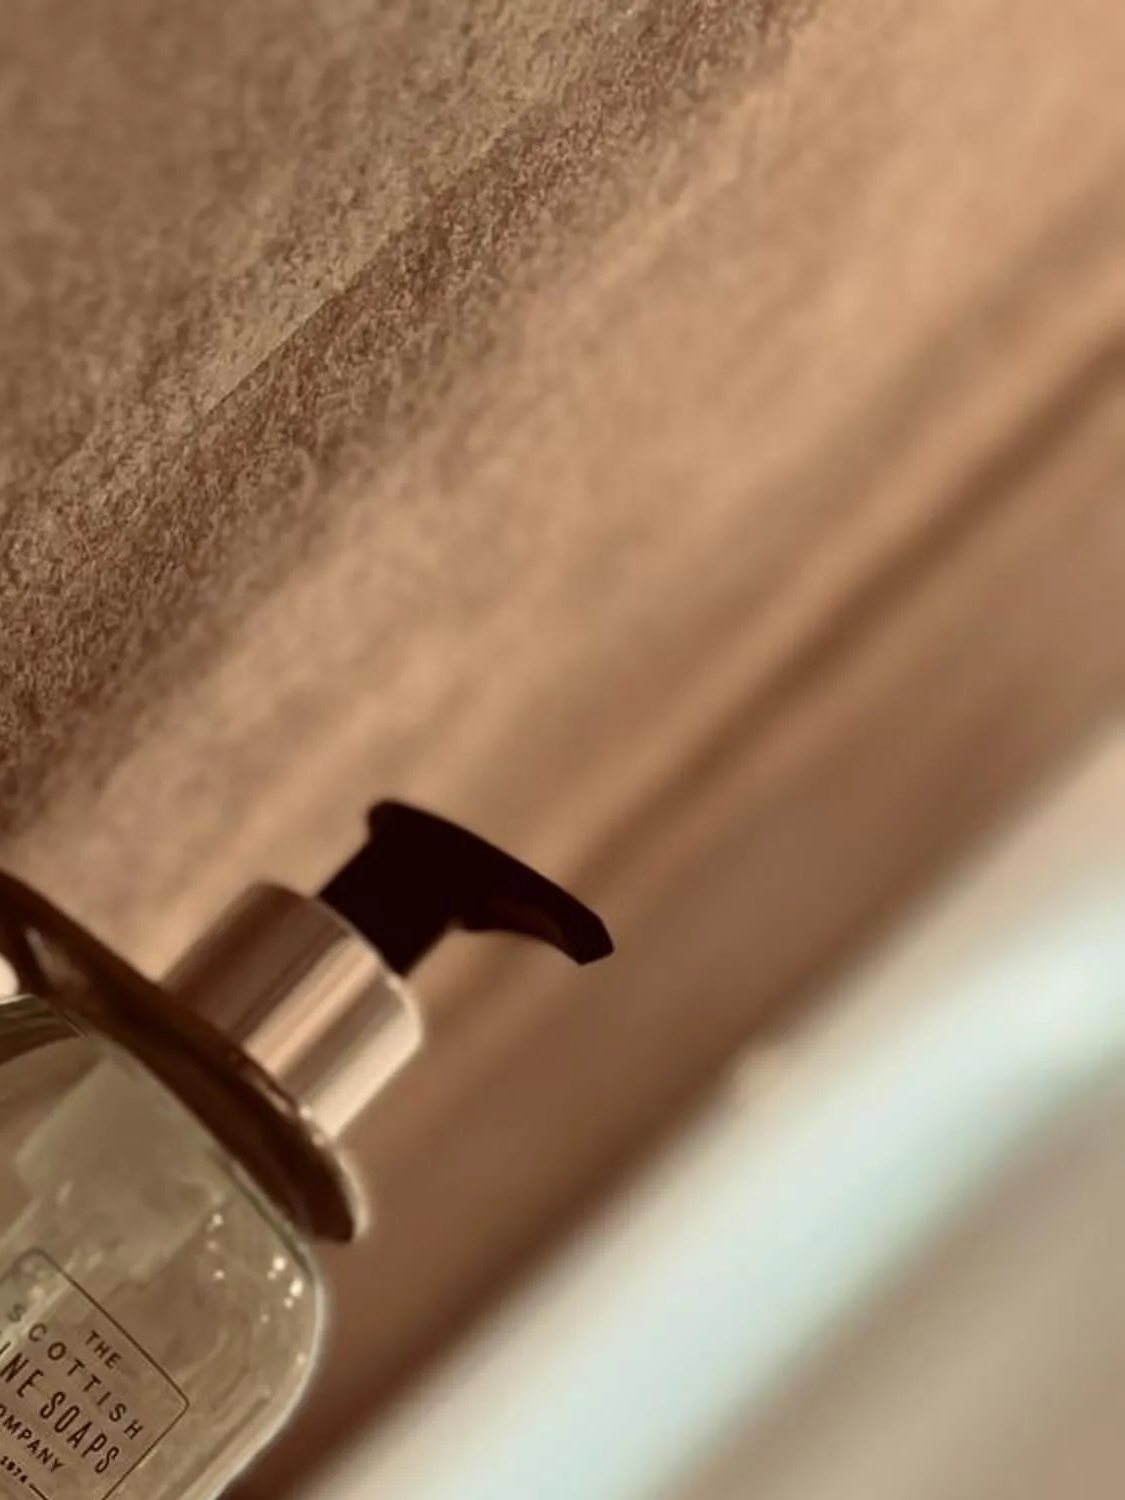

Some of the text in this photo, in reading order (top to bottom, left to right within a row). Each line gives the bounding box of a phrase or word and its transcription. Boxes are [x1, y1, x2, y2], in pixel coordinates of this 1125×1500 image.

[7, 1304, 144, 1440] SCOTTISH
[85, 1330, 121, 1369] THE
[39, 1391, 120, 1475] SOAPS
